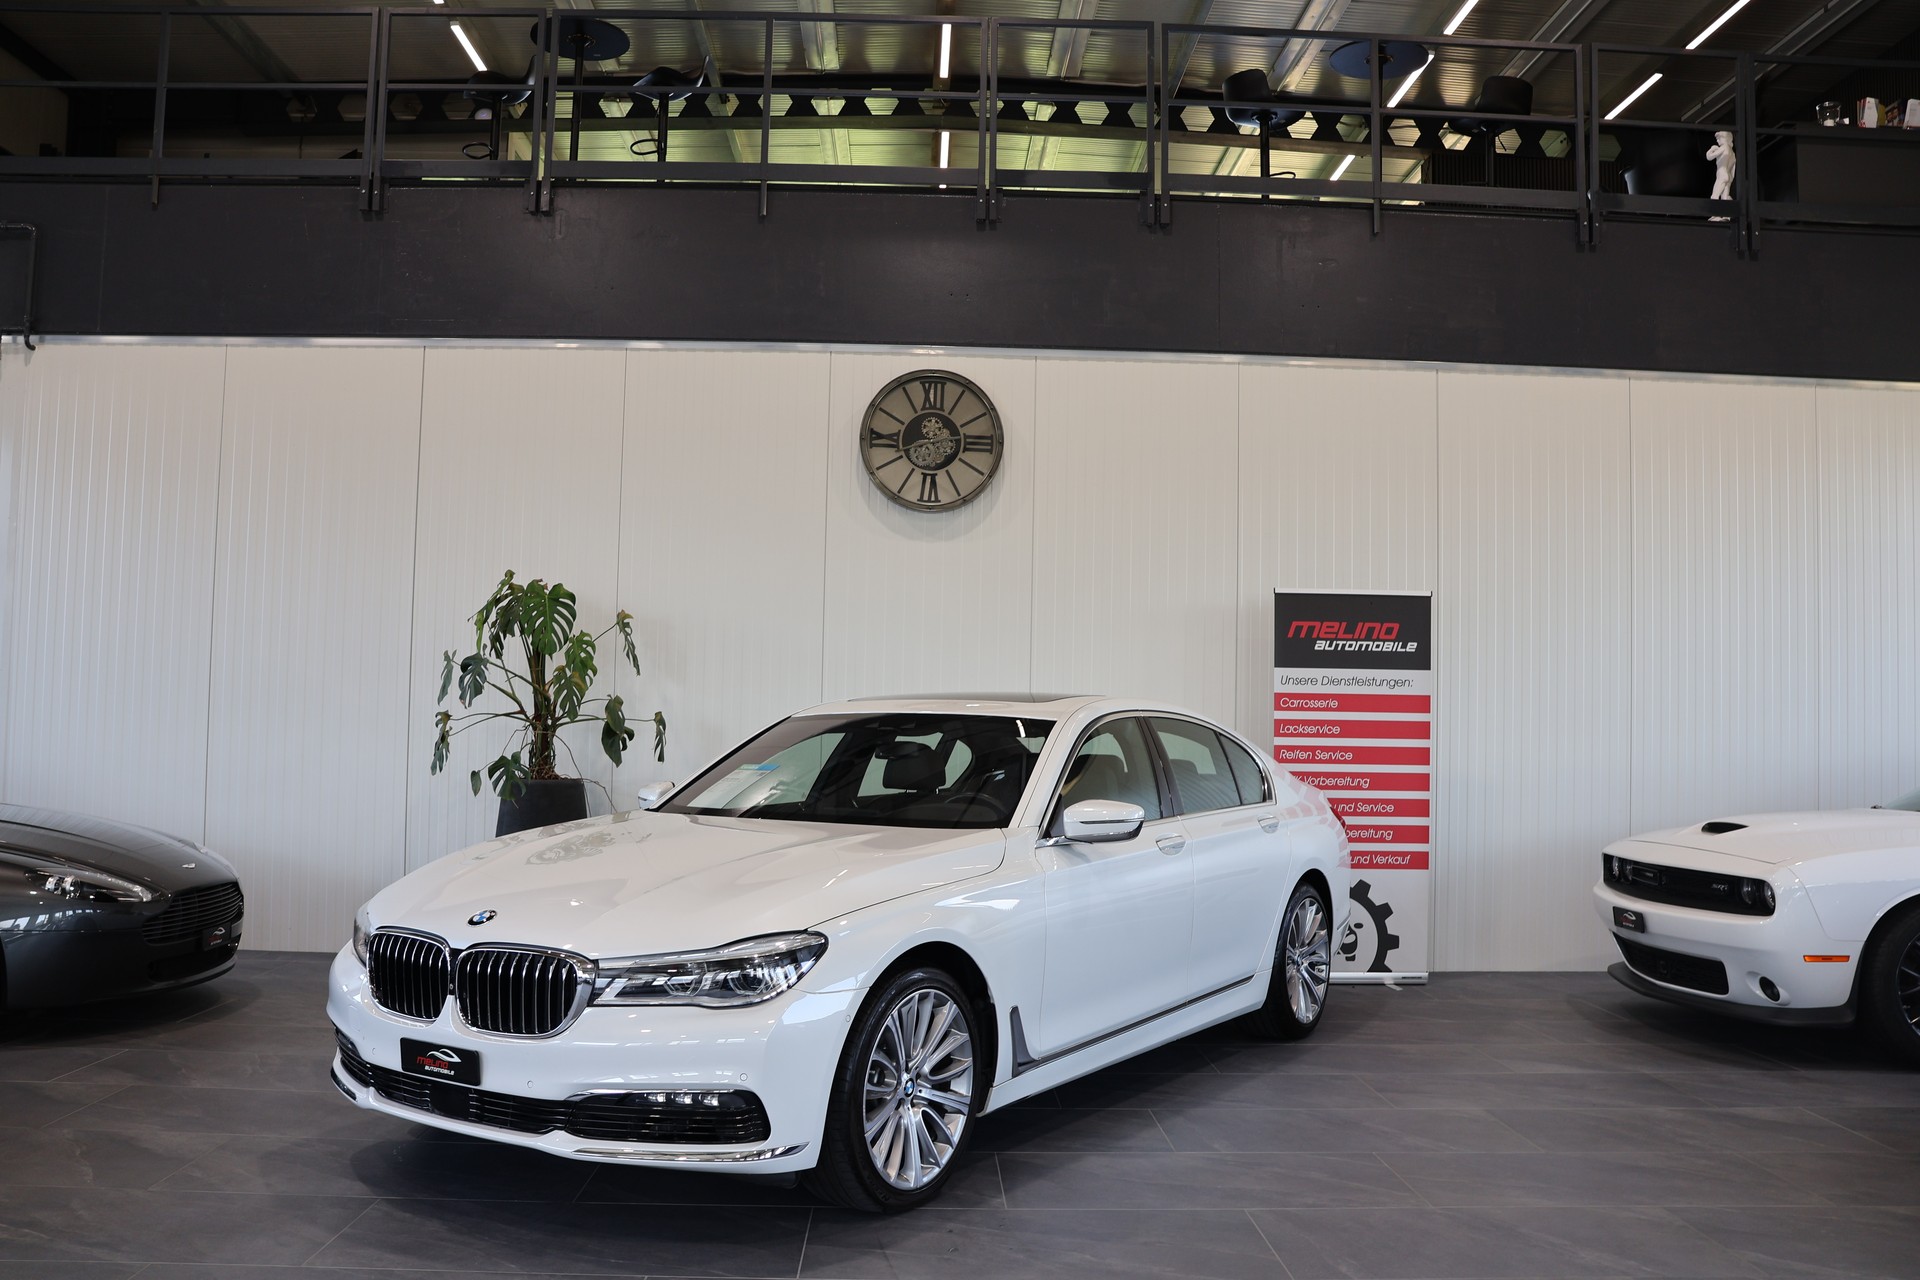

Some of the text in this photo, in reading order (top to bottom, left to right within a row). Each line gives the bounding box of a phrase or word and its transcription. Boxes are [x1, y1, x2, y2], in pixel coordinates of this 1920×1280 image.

[1314, 640, 1418, 652] AUTOMOBILE
[1280, 675, 1414, 689] Unsere Dienstleistungen:
[1279, 697, 1338, 708] Carrosserie
[1279, 723, 1341, 735] Lackservice
[1279, 749, 1353, 760] Reifen Service
[1304, 776, 1371, 789] Vorbereitung
[1356, 802, 1394, 812] Service
[1372, 854, 1411, 864] Verkauf
